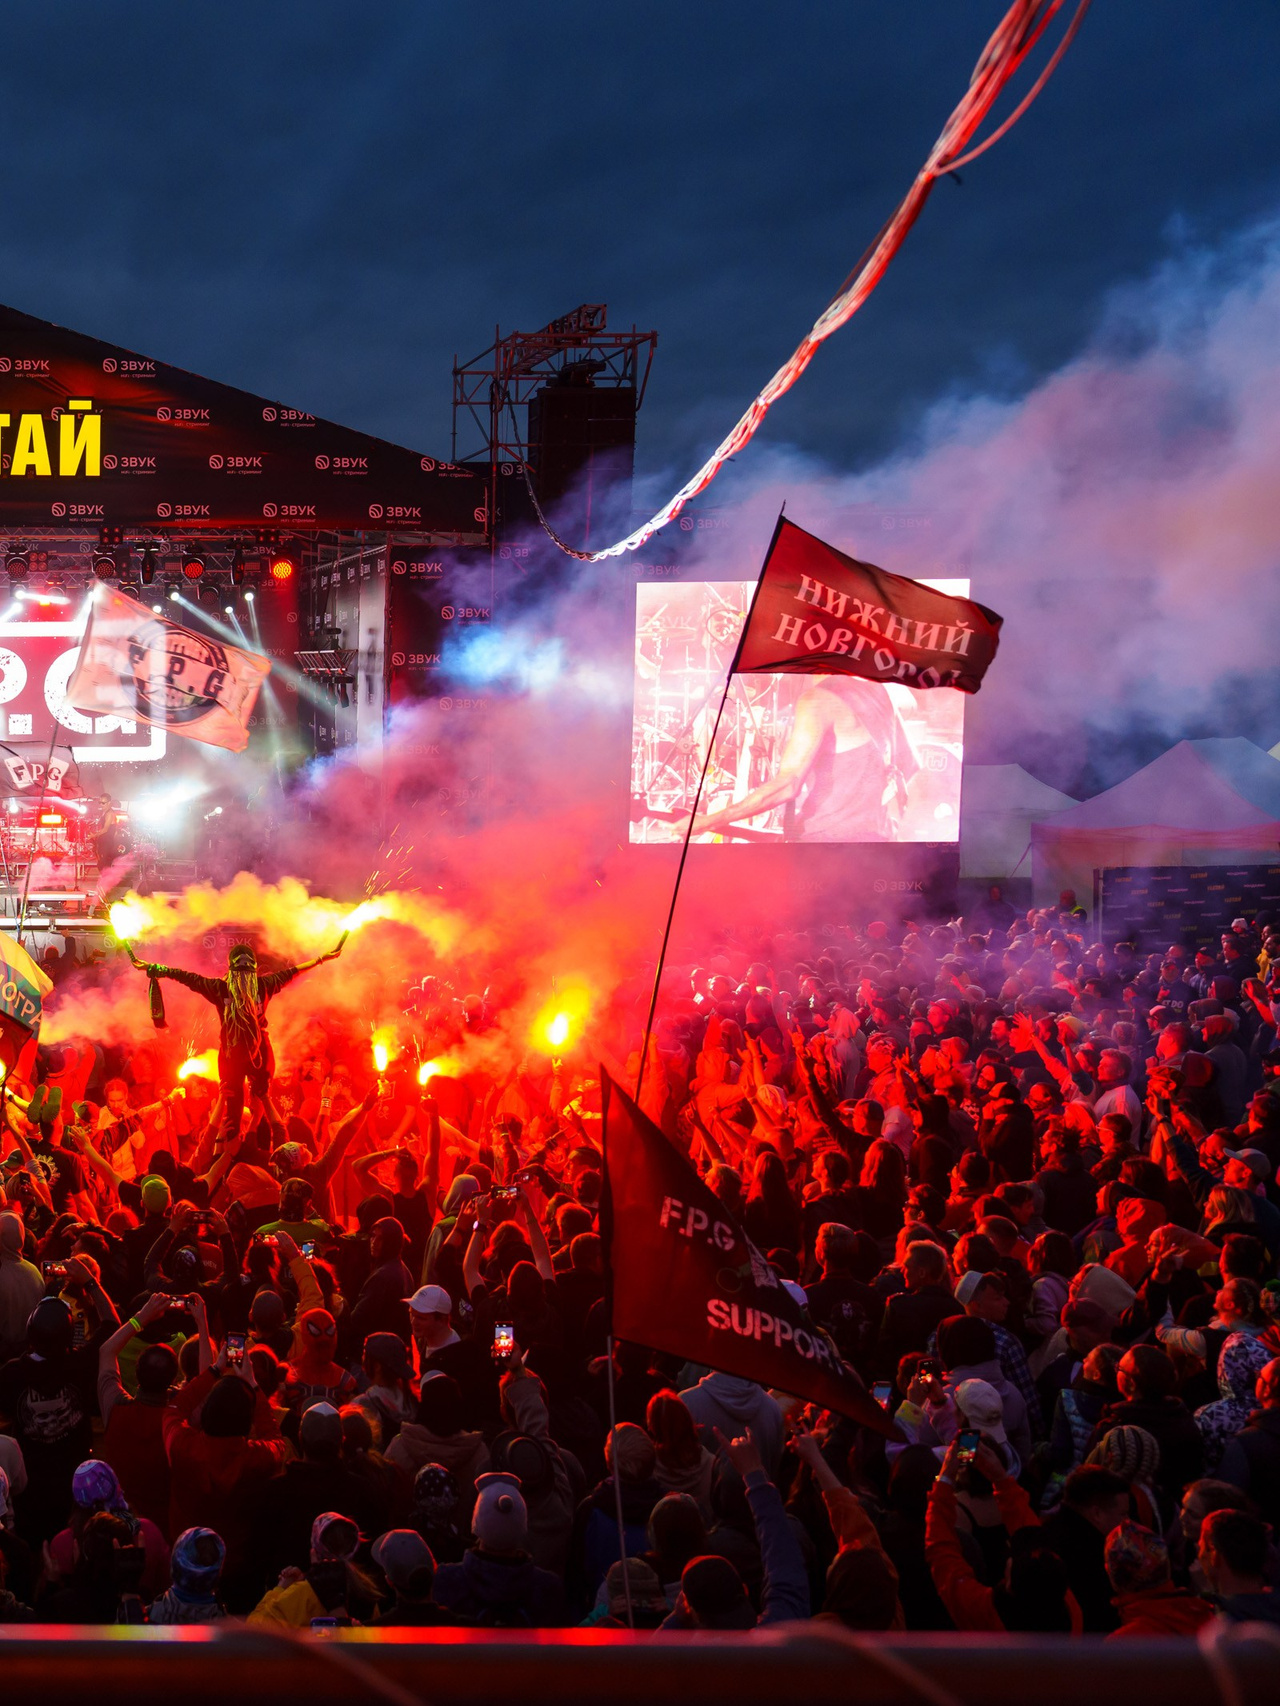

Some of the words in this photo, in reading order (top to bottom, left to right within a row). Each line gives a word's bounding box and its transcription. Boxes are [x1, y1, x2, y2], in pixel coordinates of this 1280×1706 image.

[15, 360, 49, 370] ЗВУК
[121, 361, 155, 370] ЗВУК
[175, 409, 209, 419] ЗВУК
[121, 457, 155, 467] ЗВУК
[227, 457, 262, 467] ЗВУК
[333, 458, 367, 467] ЗВУК
[70, 505, 104, 514] ЗВУК
[175, 505, 209, 515] ЗВУК
[281, 505, 315, 515] ЗВУК
[387, 507, 421, 517] ЗВУК
[410, 563, 442, 572] ЗВУК
[458, 608, 489, 618] ЗВУК
[793, 573, 974, 657] НИЖНИЙ
[409, 654, 440, 663] ЗВУК
[891, 881, 922, 891] ЗВУК
[659, 1195, 736, 1251] F.P.G
[706, 1298, 844, 1376] SUPPOR
